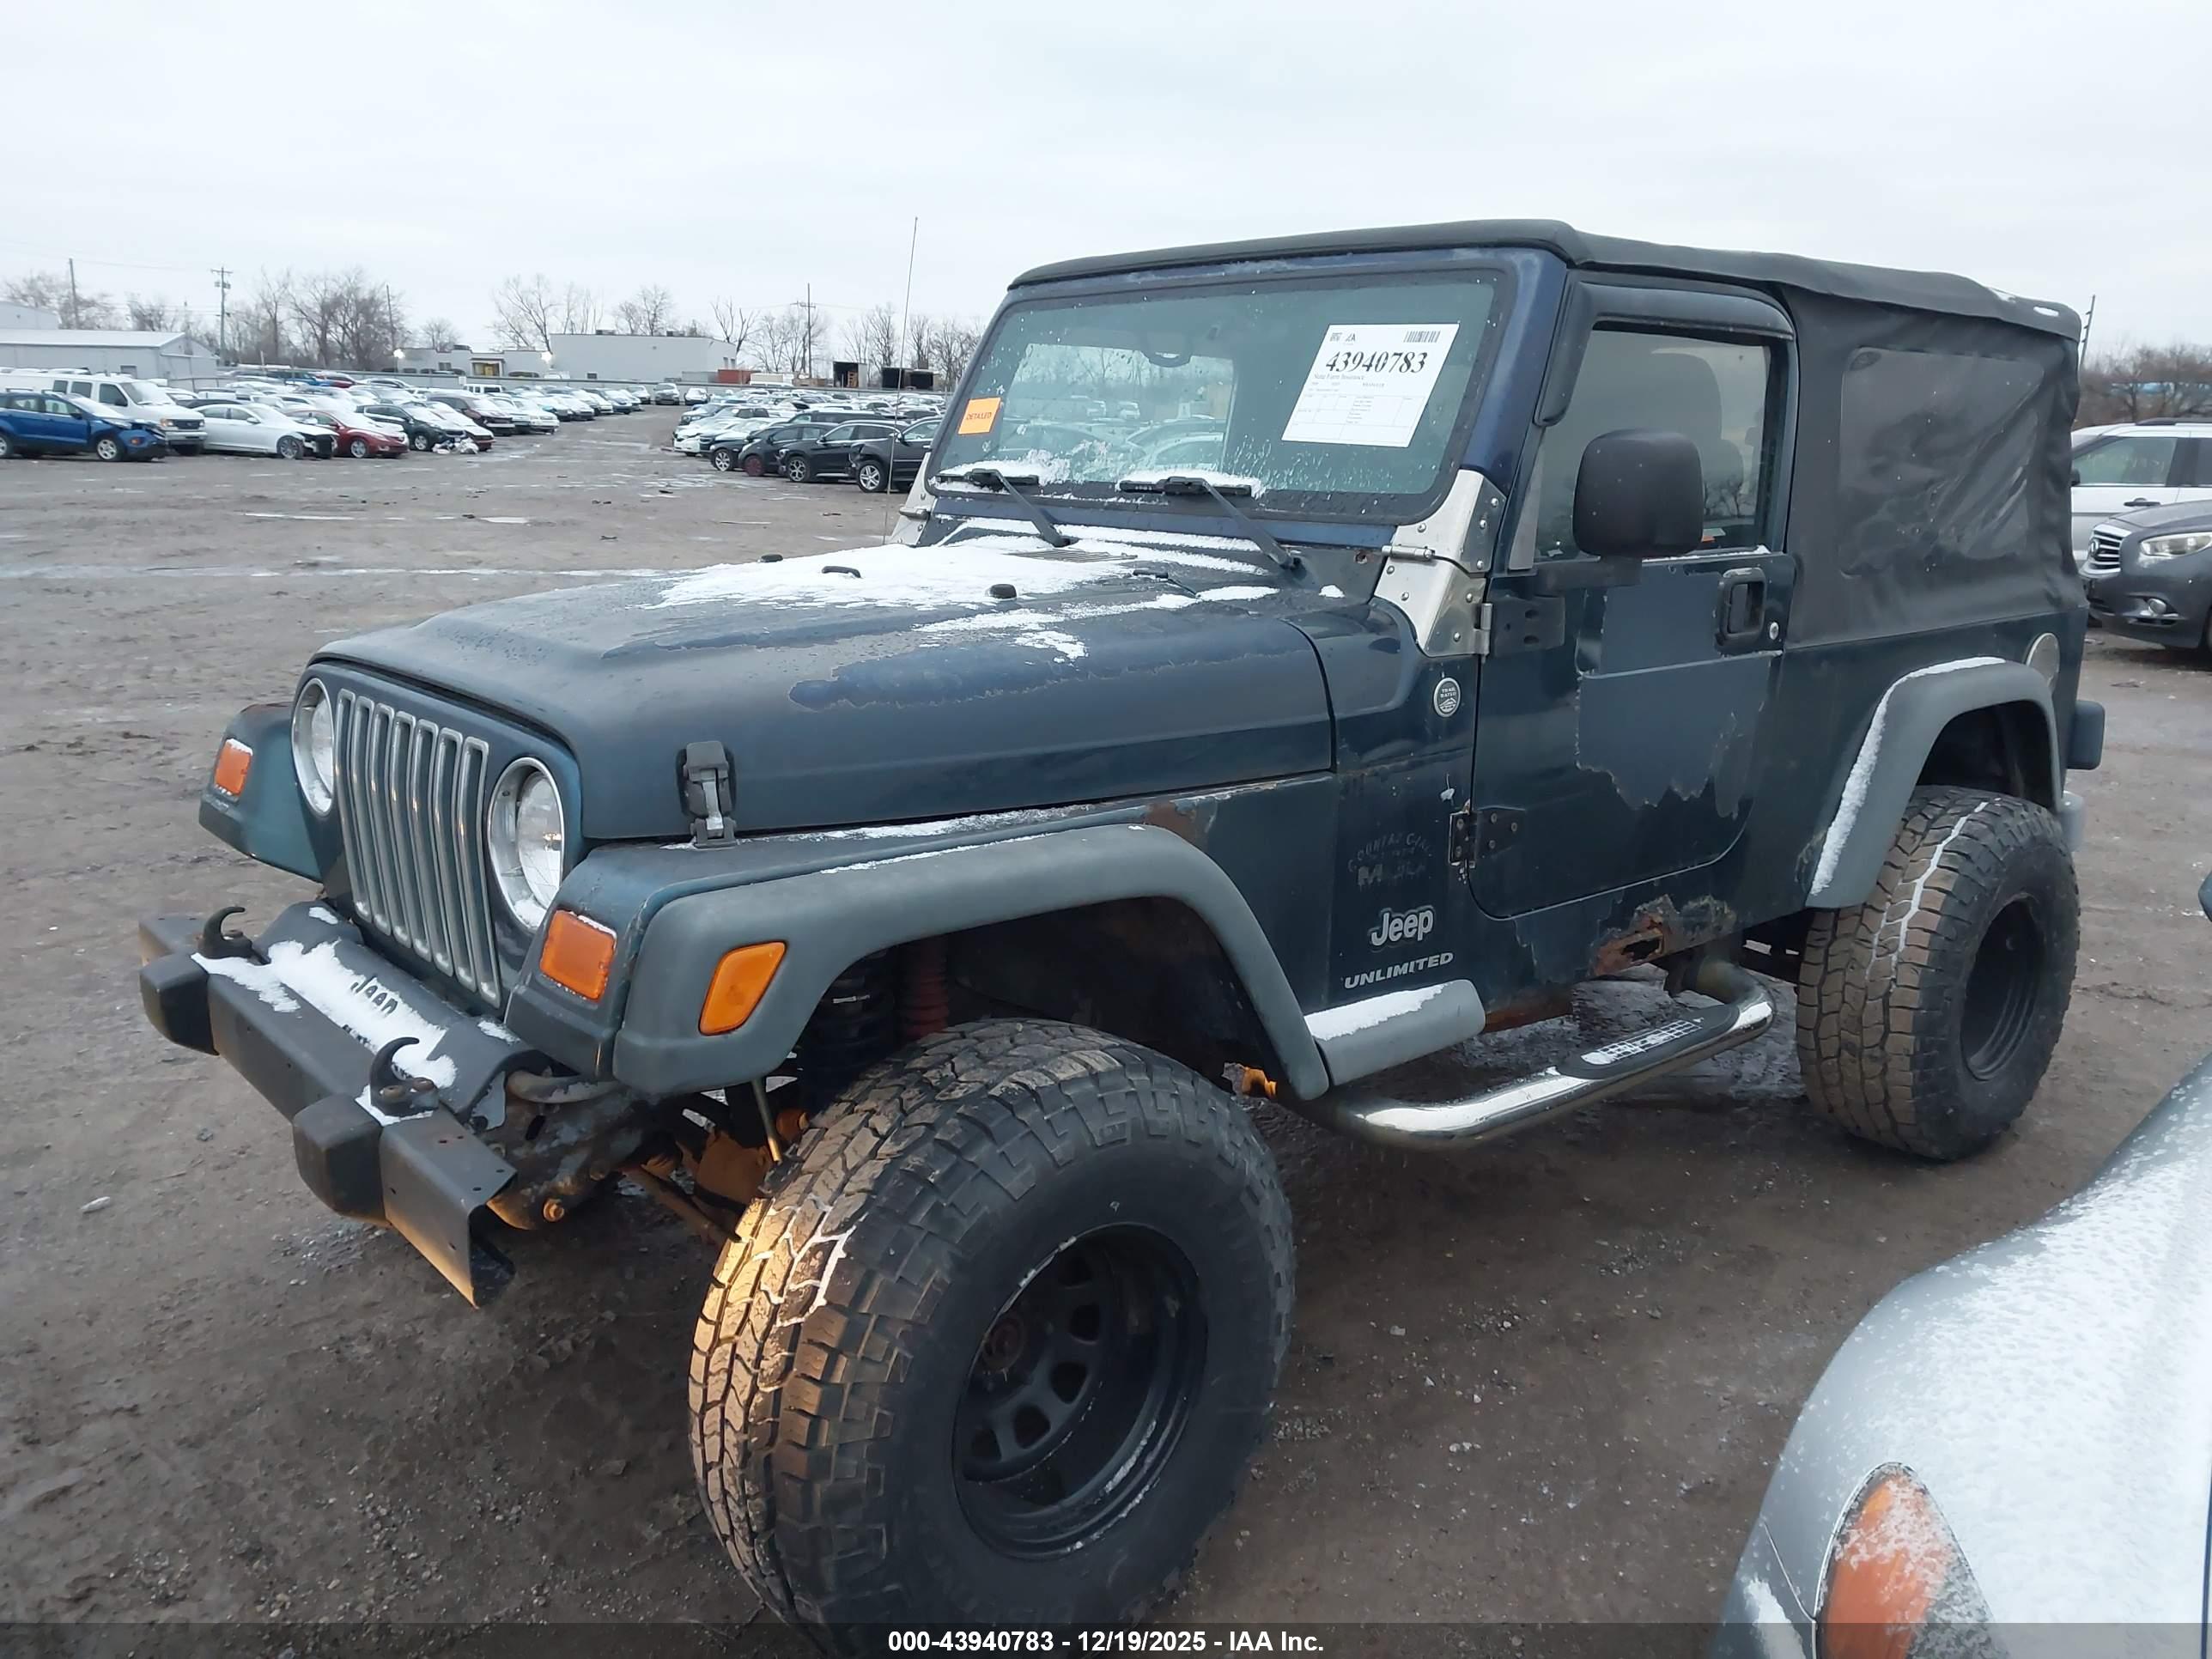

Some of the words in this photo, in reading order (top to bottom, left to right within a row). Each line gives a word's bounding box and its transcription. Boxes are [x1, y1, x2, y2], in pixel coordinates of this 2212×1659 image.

[1326, 351, 1428, 373] 43940783
[1371, 909, 1434, 945] Jeep
[1344, 952, 1454, 988] UNLIMITED
